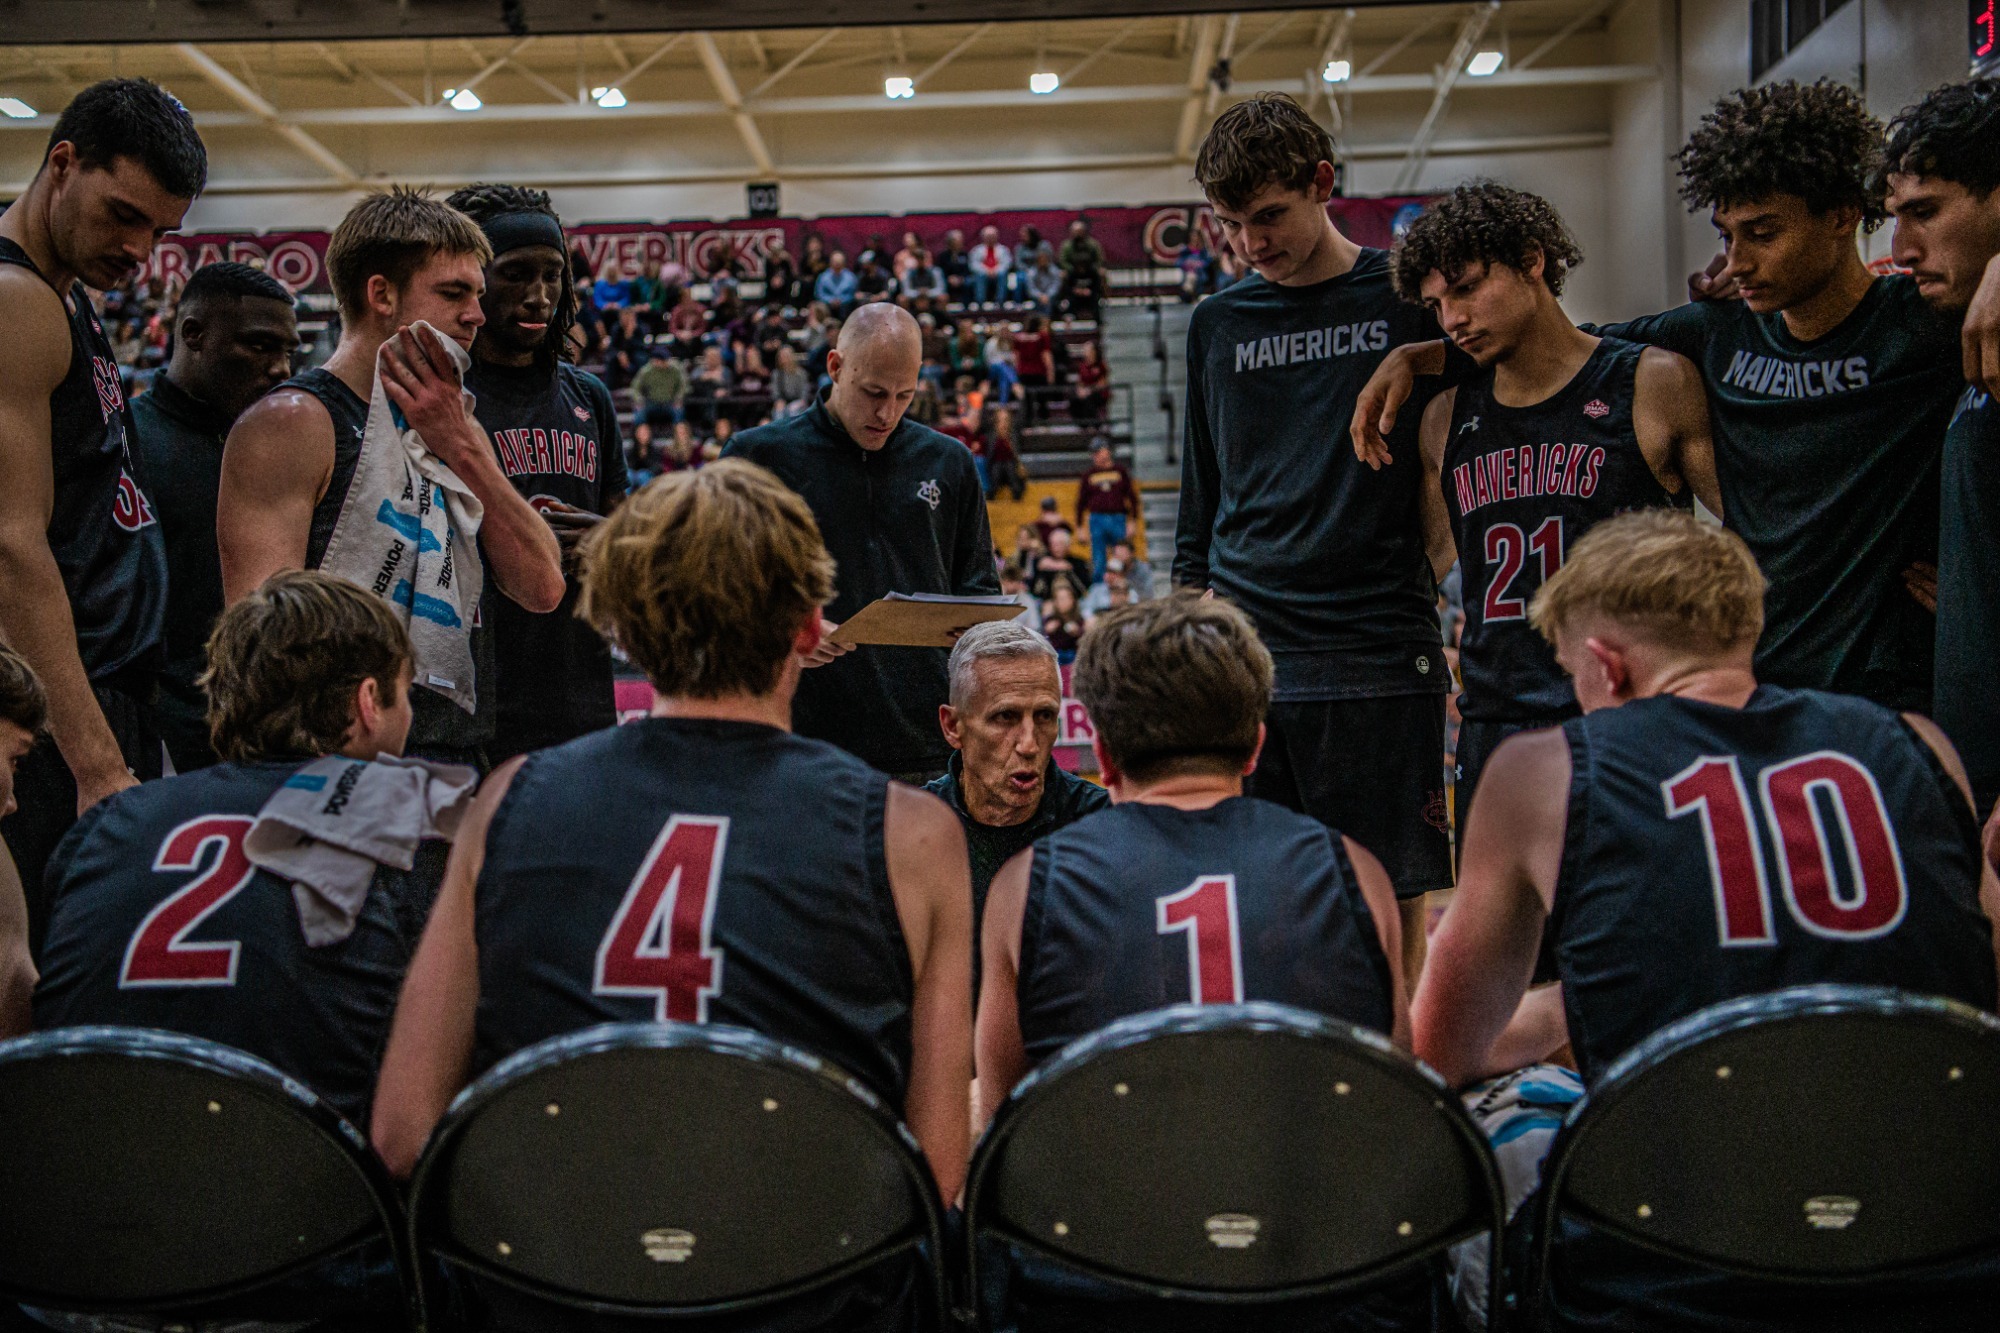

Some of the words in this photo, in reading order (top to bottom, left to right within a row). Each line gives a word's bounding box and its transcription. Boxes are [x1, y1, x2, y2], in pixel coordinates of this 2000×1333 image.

[1235, 320, 1389, 373] MAVERICKS
[1722, 350, 1870, 398] MAVERICKS
[494, 428, 598, 483] AVERICKS
[1453, 443, 1606, 517] MAVERICKS
[372, 538, 404, 598] POWER
[1483, 515, 1564, 624] 21
[1660, 750, 1909, 948] 10
[118, 814, 257, 989] 2
[592, 813, 730, 1024] 4
[1156, 874, 1244, 1006] 1
